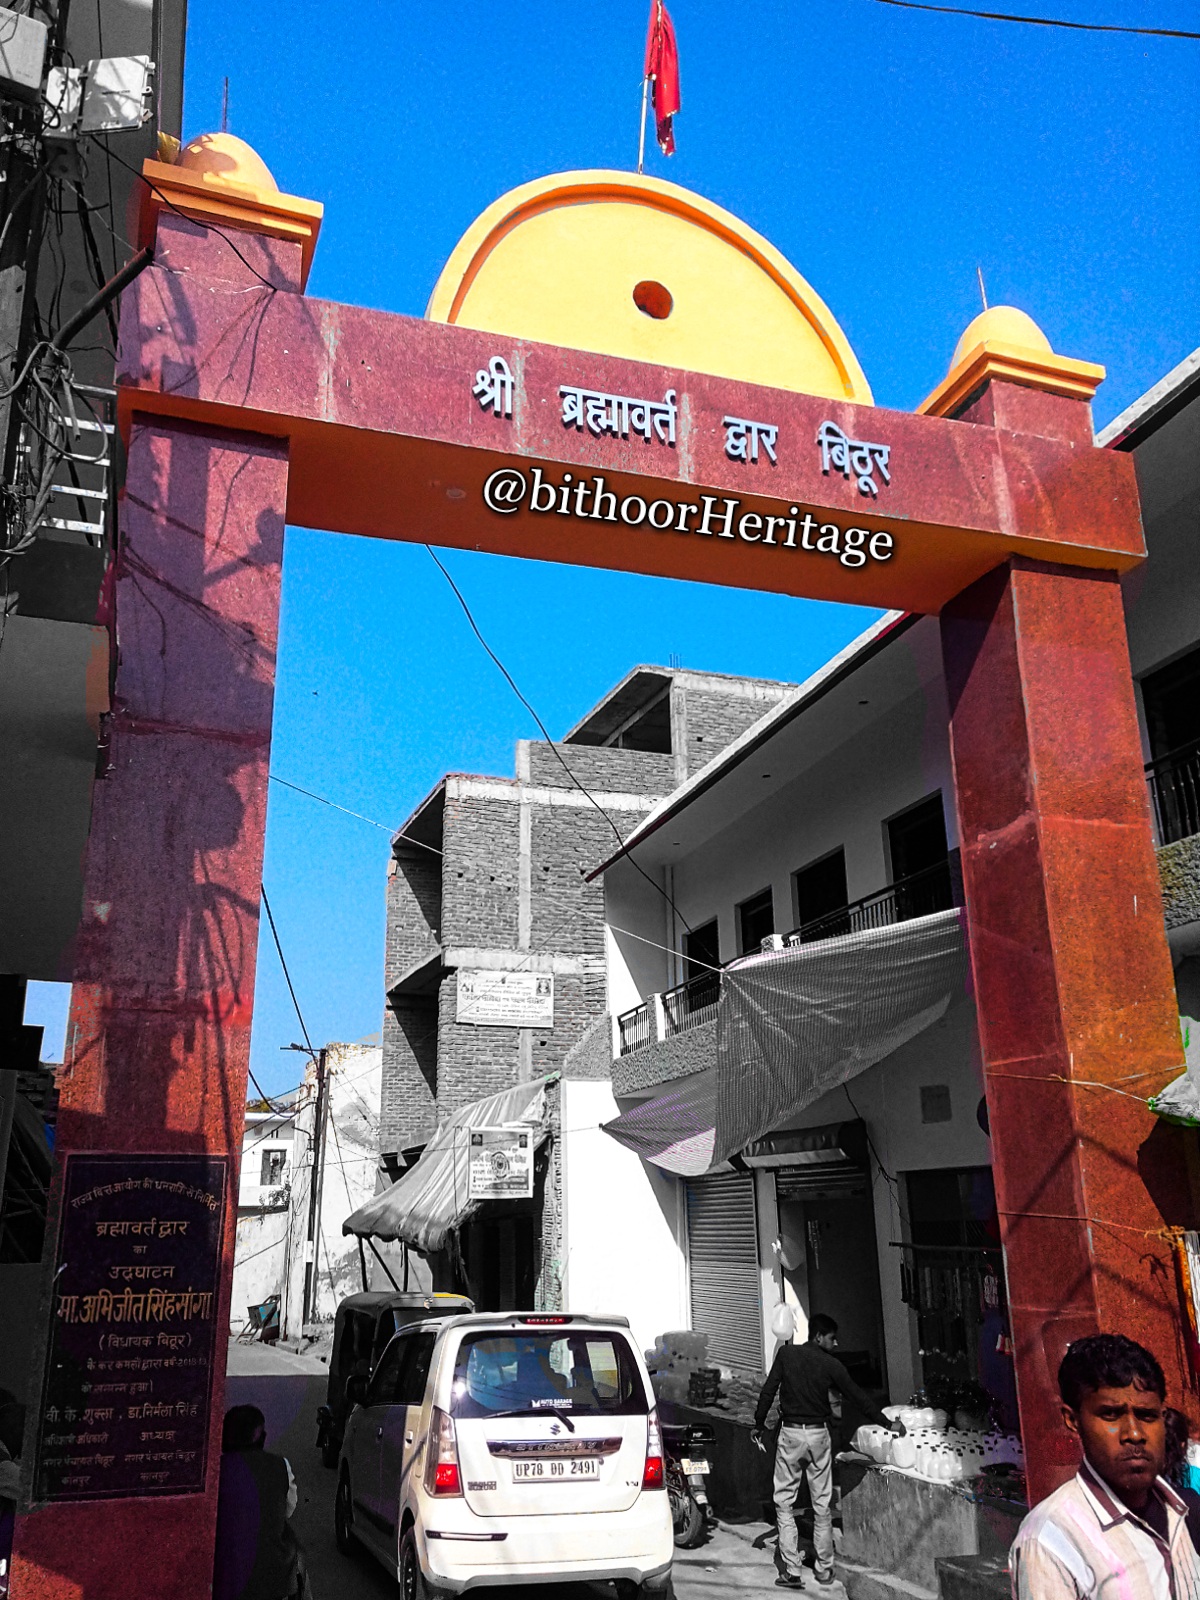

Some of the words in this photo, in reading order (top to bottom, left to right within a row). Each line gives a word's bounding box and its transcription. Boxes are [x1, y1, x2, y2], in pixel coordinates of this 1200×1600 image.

[472, 355, 514, 416] श्री
[559, 384, 678, 444] ब्रह्मावर्त
[723, 415, 779, 462] द्वार
[820, 420, 891, 498] बिठूर
[70, 1191, 92, 1209] राज्य
[113, 1177, 142, 1192] आयोग
[143, 1177, 153, 1189] की
[194, 1189, 220, 1211] निर्मित
[95, 1217, 156, 1237] ब्रह्मावर्त
[158, 1221, 190, 1239] द्वार
[132, 1245, 148, 1255] का
